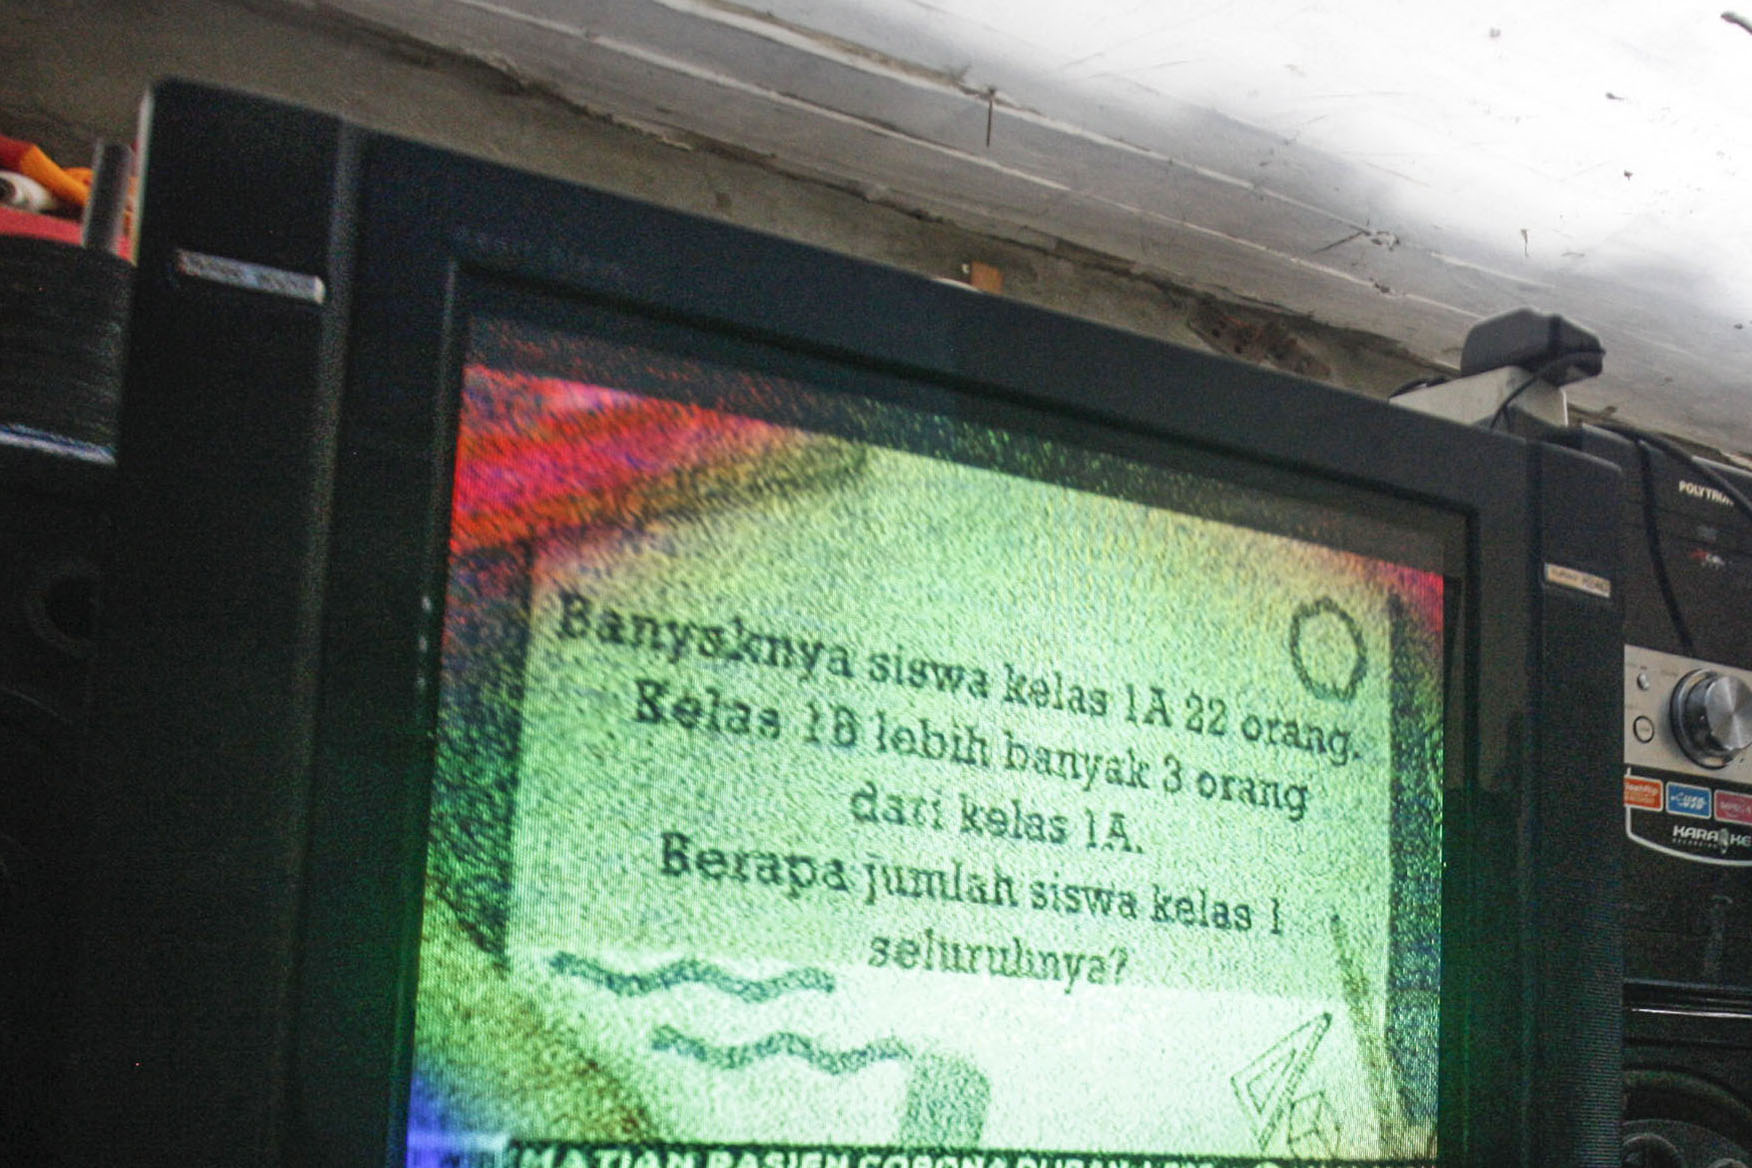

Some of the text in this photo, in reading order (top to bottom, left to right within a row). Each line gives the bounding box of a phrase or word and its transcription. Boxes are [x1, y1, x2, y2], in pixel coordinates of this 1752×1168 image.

[1678, 480, 1735, 507] POLYTR
[556, 592, 855, 688] Banyaknya
[868, 644, 989, 701] siswa
[1003, 661, 1108, 719] kelas
[1186, 694, 1228, 738] 22
[1241, 711, 1363, 767] orang.
[633, 677, 782, 740] Kelas
[876, 709, 990, 770] lebih
[1004, 730, 1150, 791] banyak
[1161, 754, 1184, 794] 3
[1199, 768, 1310, 822] orang
[850, 782, 943, 828] dari
[960, 792, 1069, 845] kelas
[660, 830, 851, 899] Berapa
[866, 850, 1016, 907] jumlah
[1030, 870, 1138, 921] siswa
[1150, 883, 1253, 930] kelas
[868, 926, 1129, 994] seluruhnya?
